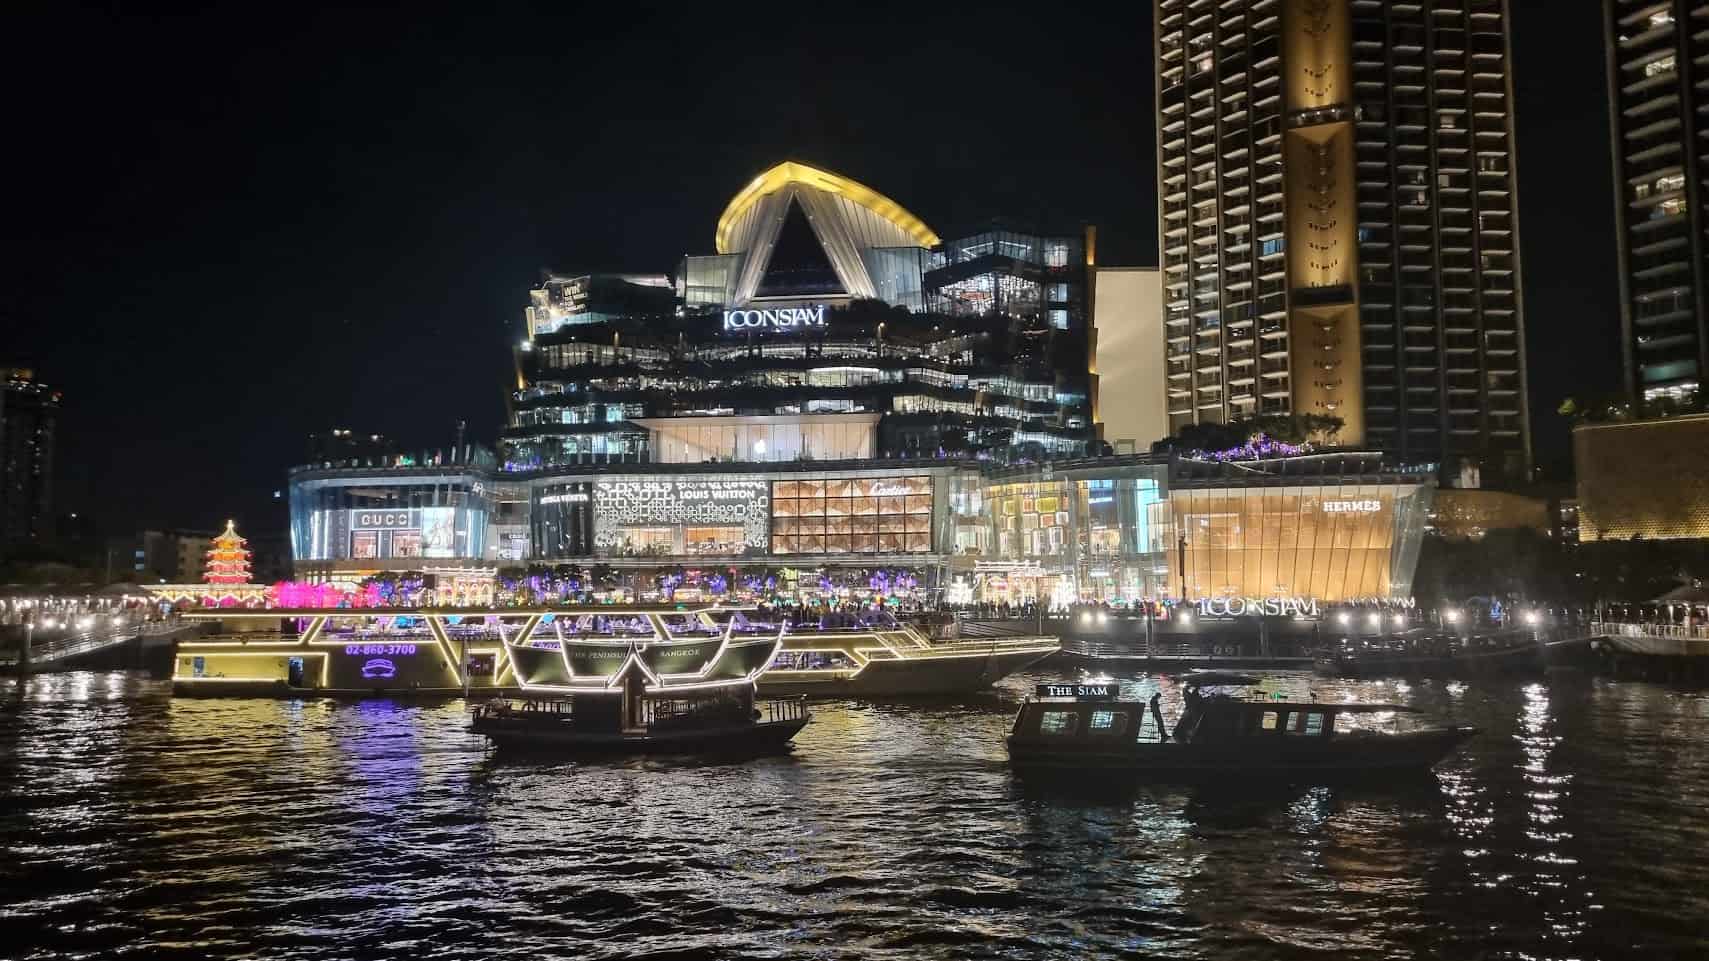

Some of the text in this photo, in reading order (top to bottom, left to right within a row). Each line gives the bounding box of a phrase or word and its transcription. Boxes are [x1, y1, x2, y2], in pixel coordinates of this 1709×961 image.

[723, 304, 825, 331] ICONSIAM
[680, 490, 755, 499] LOUIS VUITTON
[1199, 598, 1321, 616] ICONSIAM
[346, 645, 416, 655] 02-860-3700
[1047, 686, 1108, 695] THE SIAM
